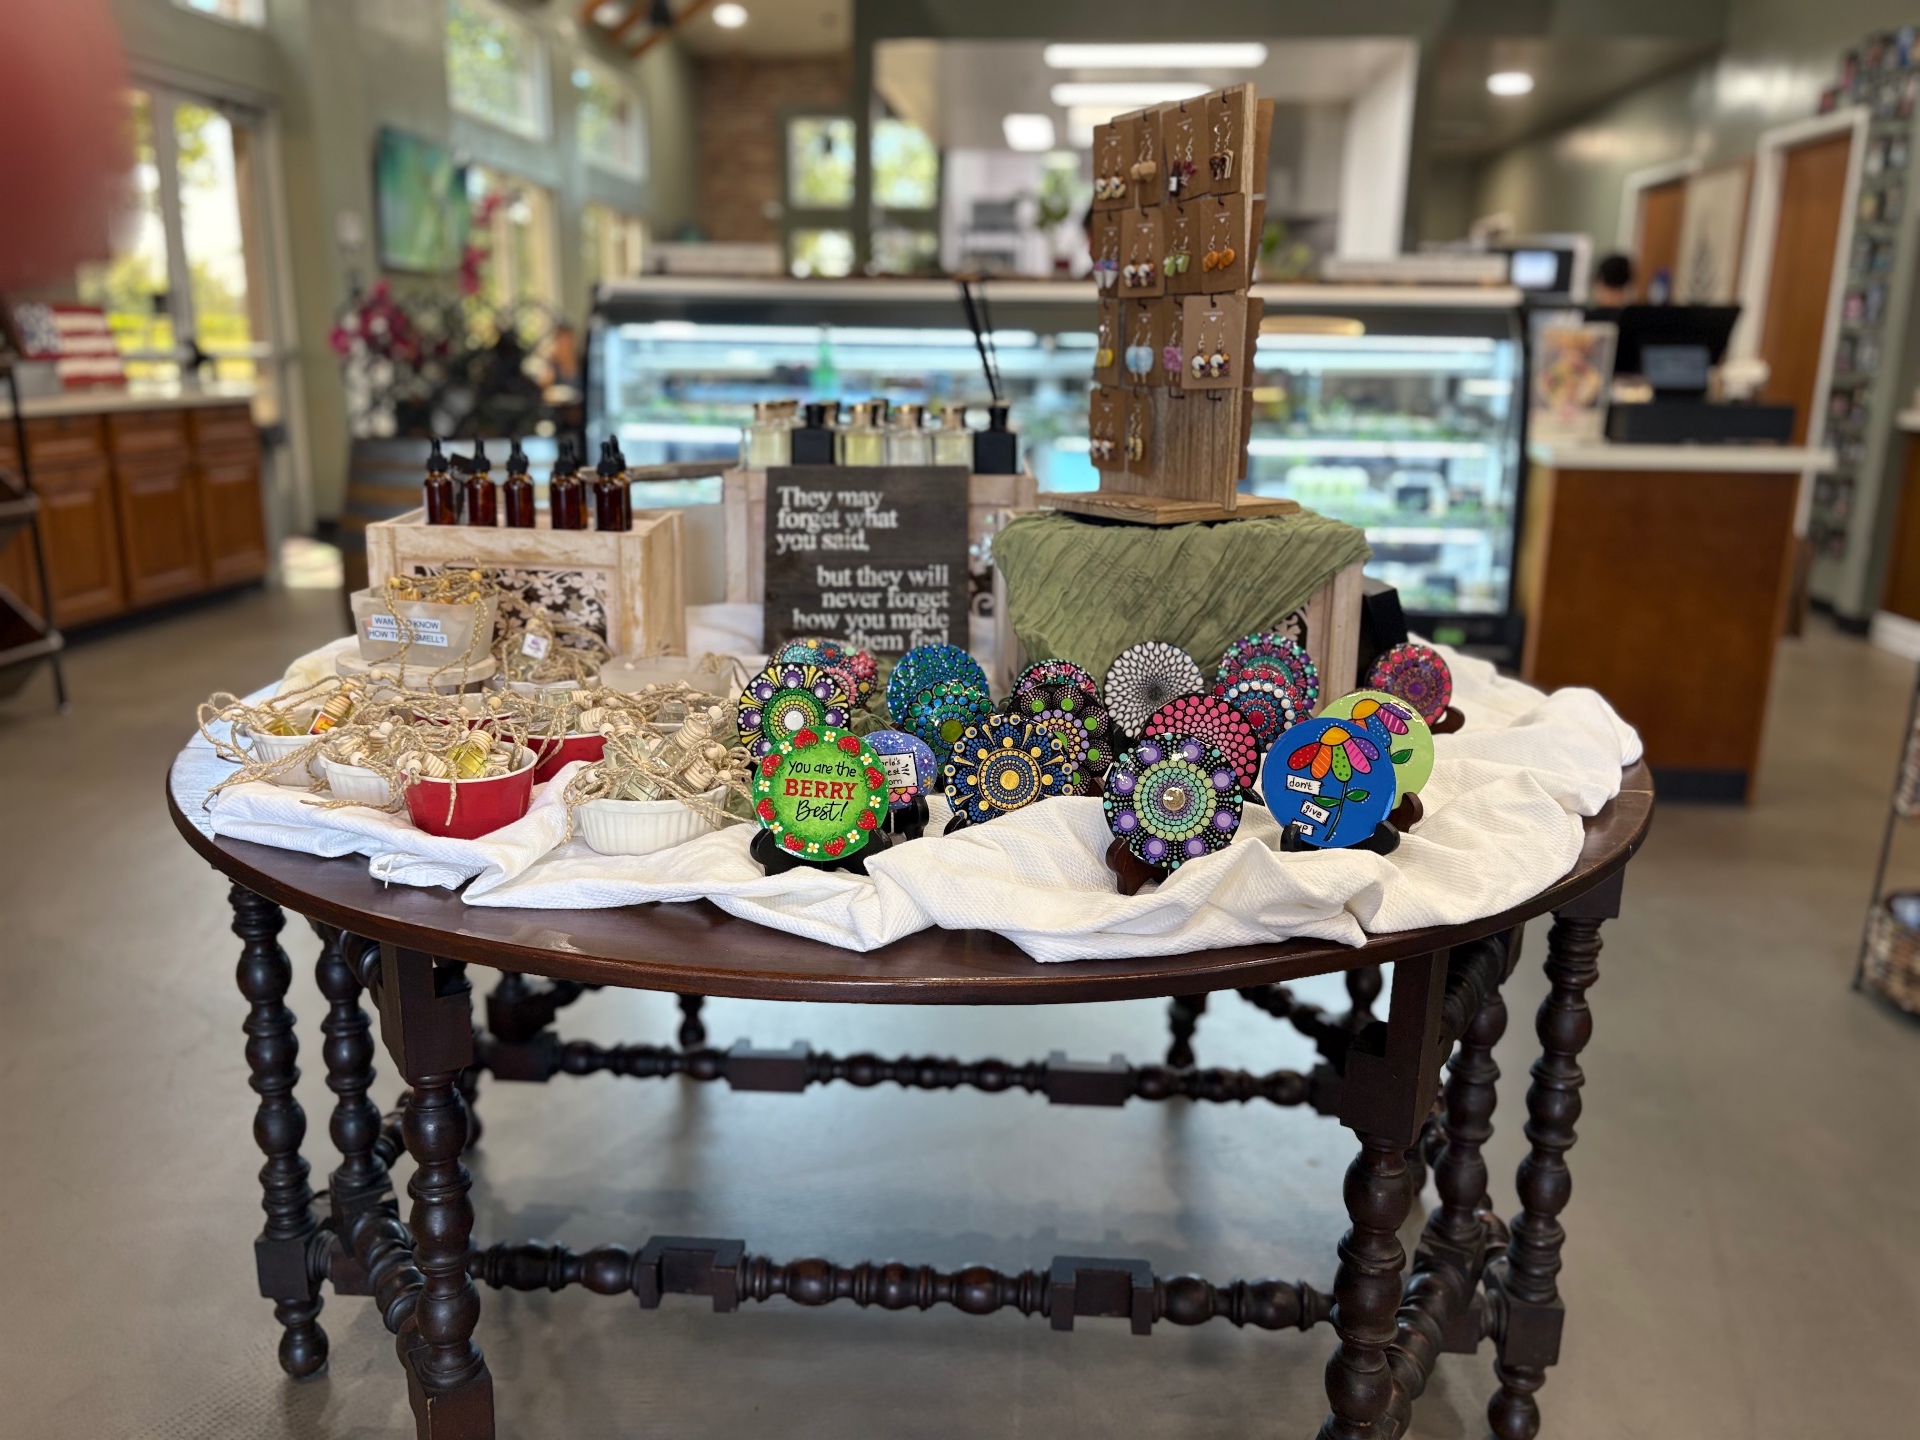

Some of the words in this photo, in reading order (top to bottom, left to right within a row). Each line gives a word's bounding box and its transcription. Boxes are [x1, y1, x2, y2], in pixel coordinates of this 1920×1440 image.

[776, 486, 833, 511] They
[837, 491, 884, 510] may
[776, 507, 840, 533] forget
[845, 508, 898, 528] what
[775, 532, 817, 555] you
[816, 564, 851, 587] but
[856, 565, 903, 590] they
[907, 564, 949, 587] will
[822, 592, 881, 608] never
[886, 586, 950, 613] forget
[413, 620, 439, 630] KNOW
[792, 608, 840, 630] how
[844, 612, 886, 635] you
[890, 608, 950, 630] made
[369, 630, 388, 638] HOW
[414, 634, 445, 643] SMELL?
[849, 630, 903, 650] them
[910, 630, 949, 646] feel
[813, 763, 833, 774] are
[836, 760, 856, 777] the
[881, 757, 900, 766] rld's
[886, 768, 901, 776] est
[783, 778, 858, 801] BERRY
[1290, 777, 1313, 790] don't
[795, 799, 849, 822] Best!
[1303, 805, 1322, 818] give
